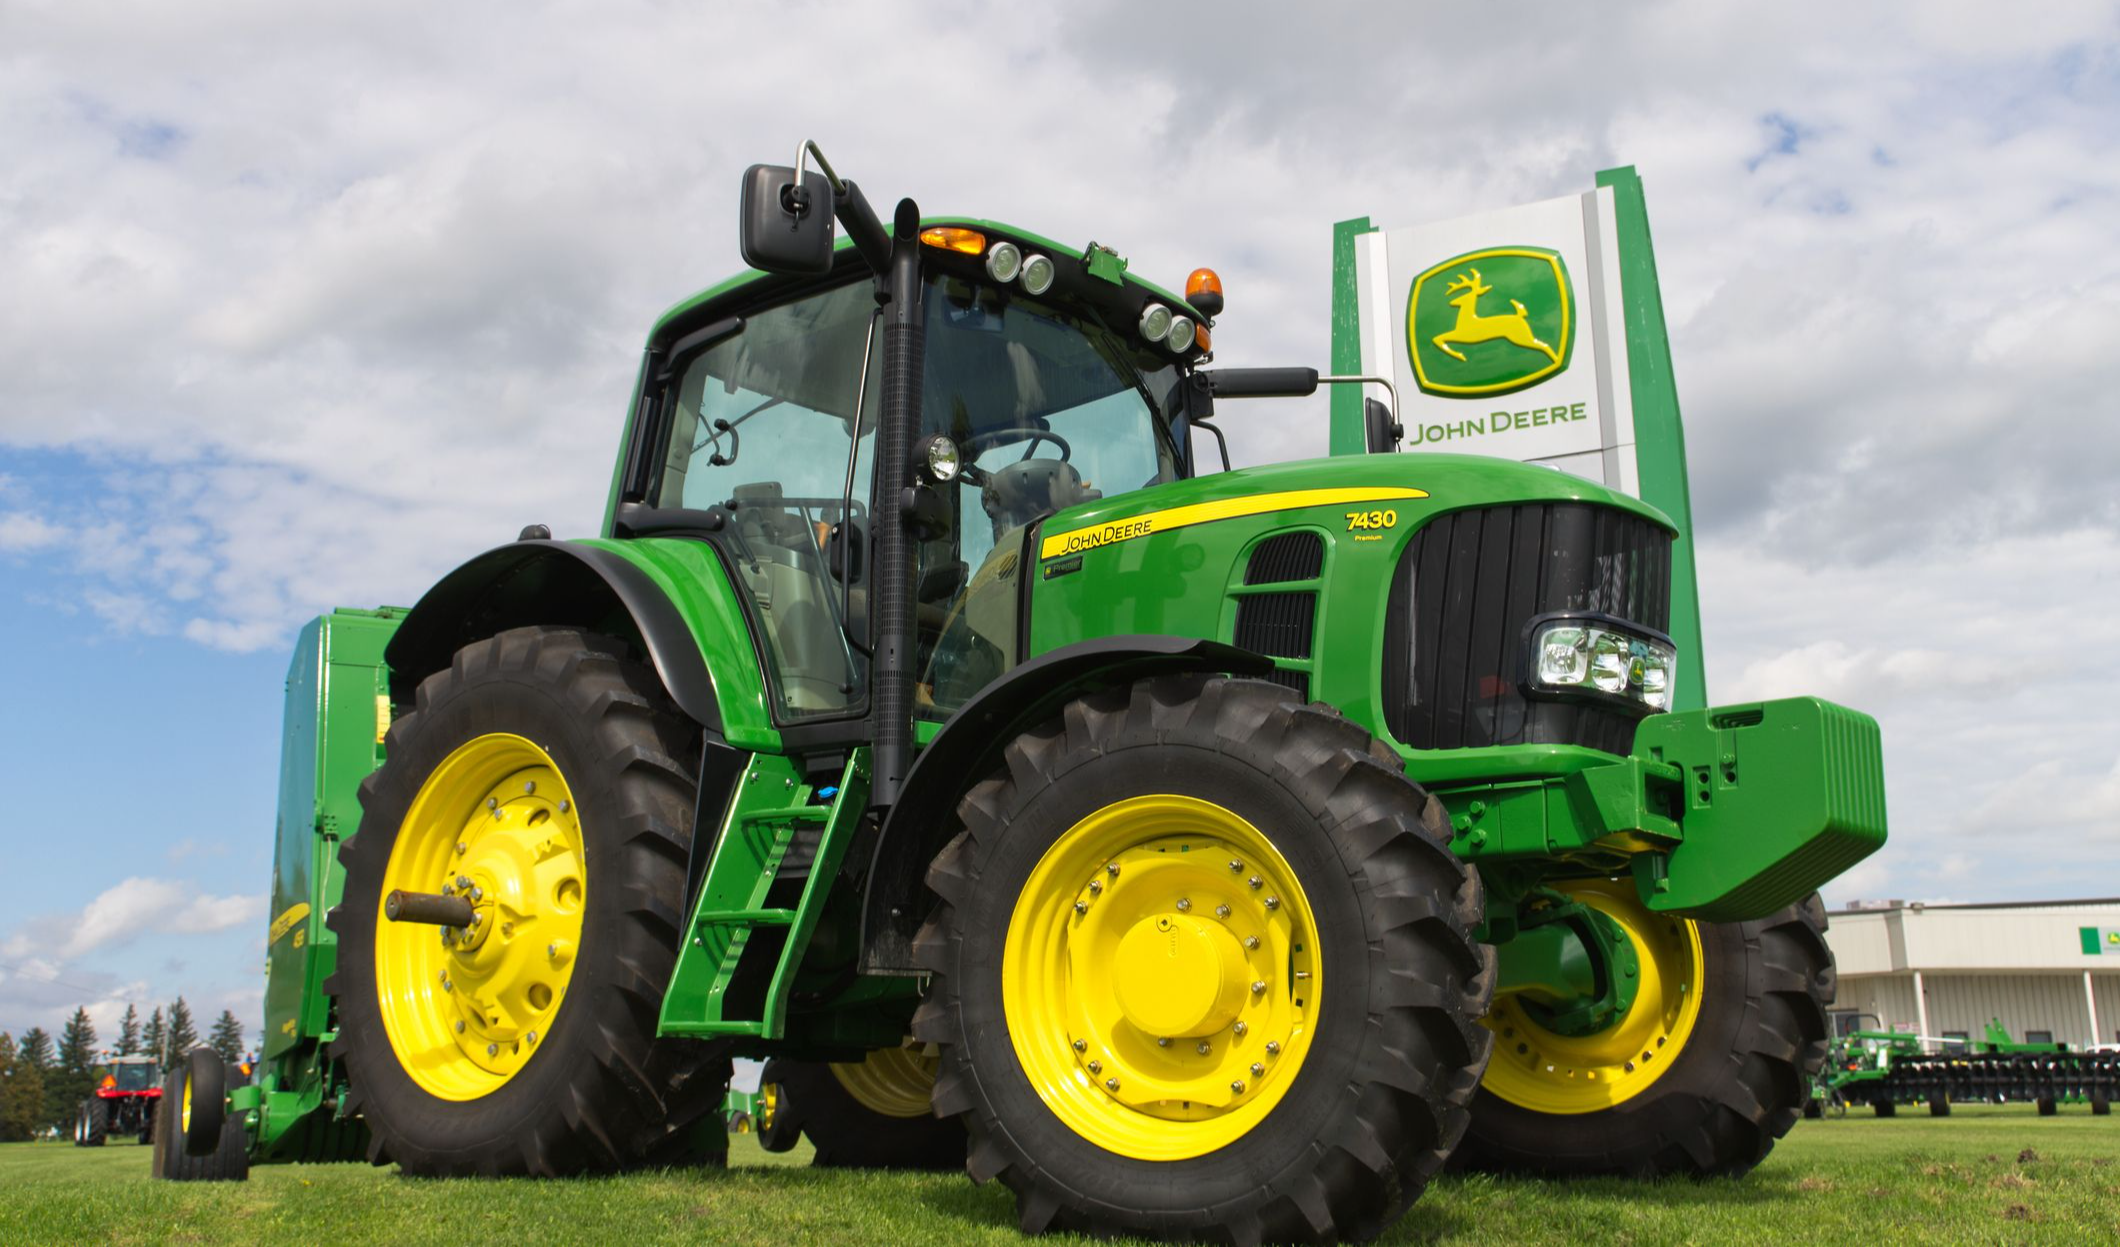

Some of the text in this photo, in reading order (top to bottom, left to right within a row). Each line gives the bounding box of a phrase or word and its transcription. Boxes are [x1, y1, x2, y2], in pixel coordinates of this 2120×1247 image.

[1410, 402, 1587, 446] JOHN DEERE
[1061, 520, 1152, 553] JOHN DEERE
[1346, 509, 1397, 531] 7430
